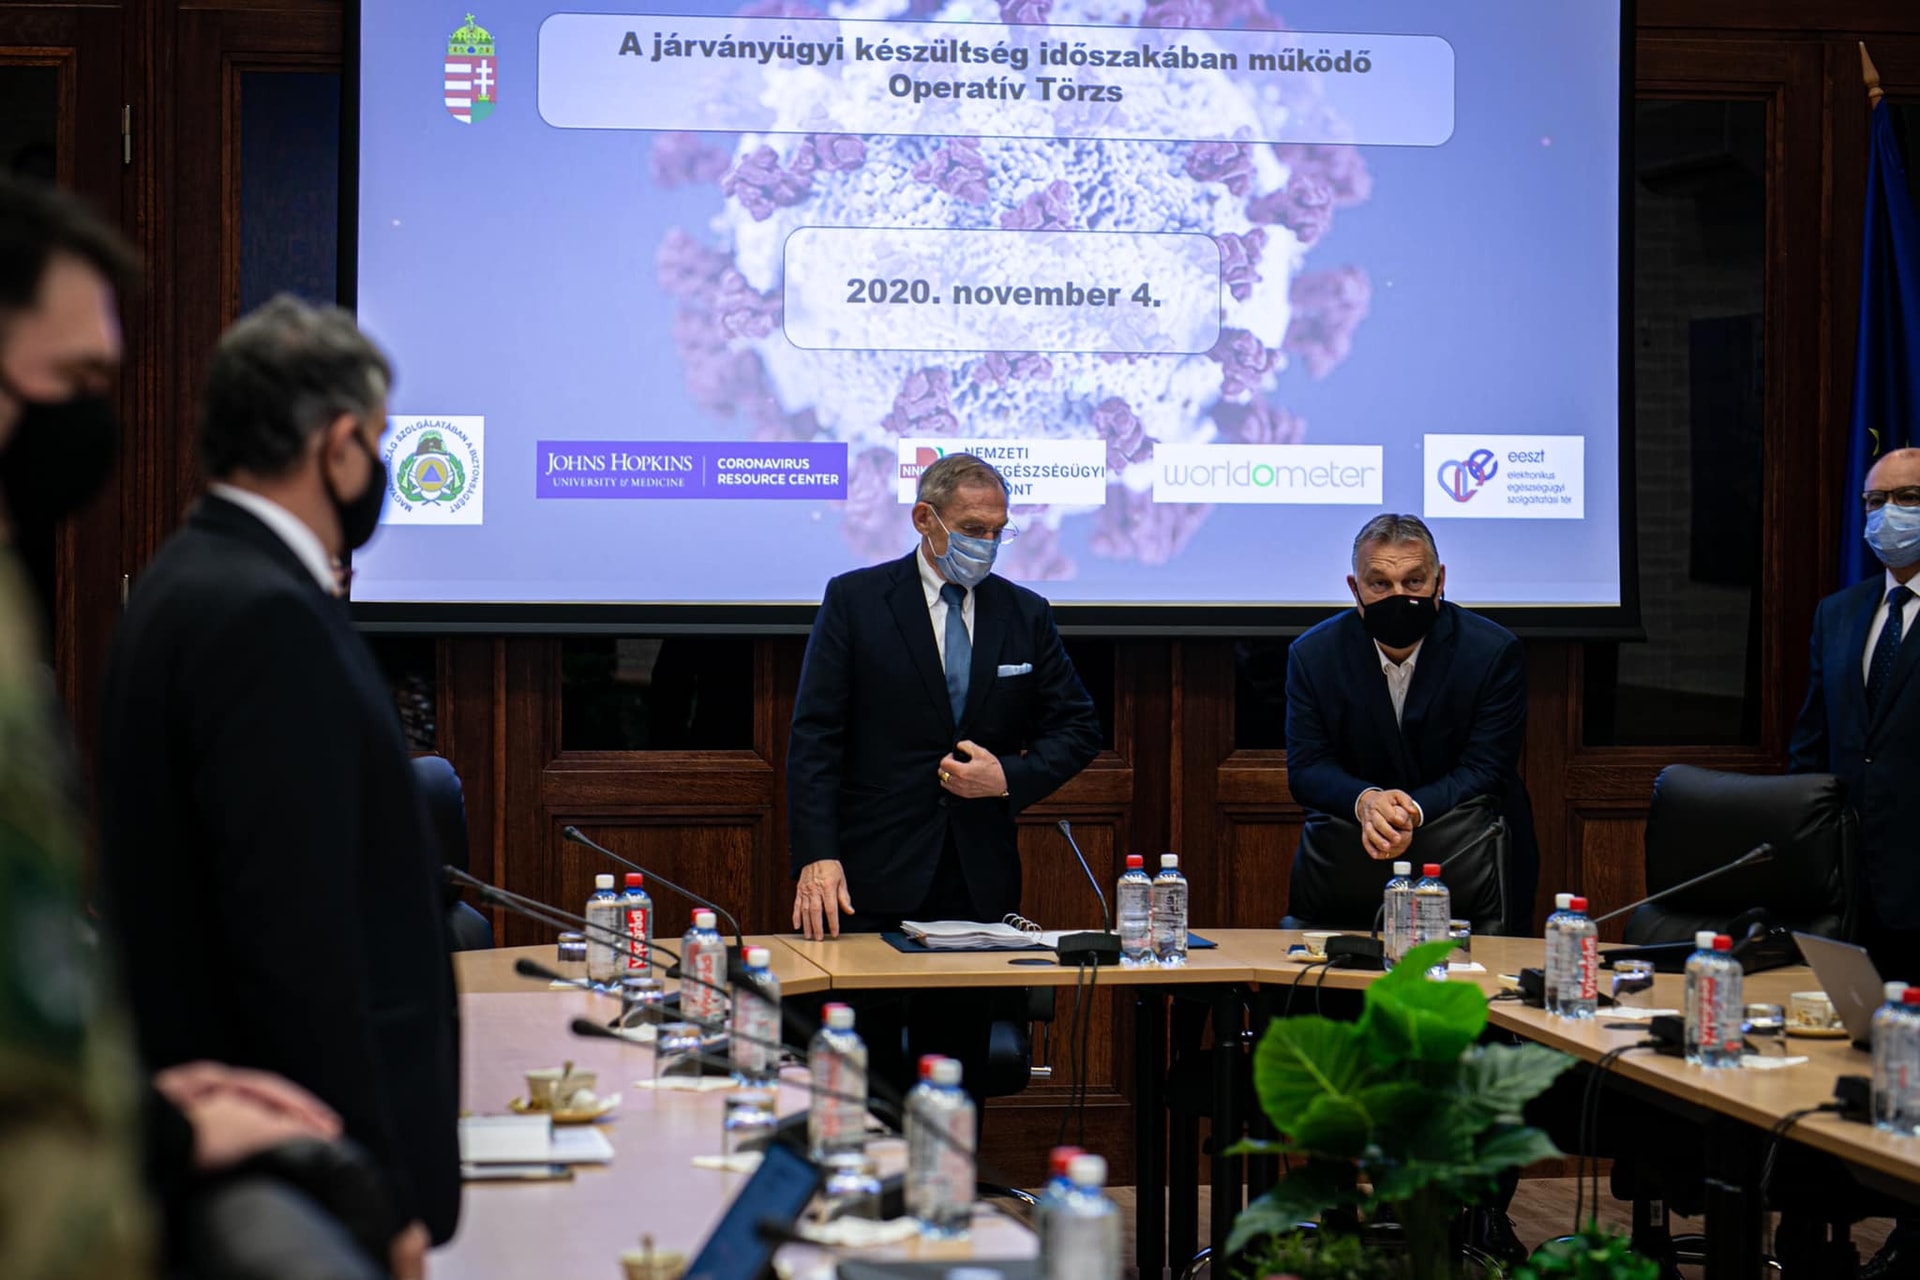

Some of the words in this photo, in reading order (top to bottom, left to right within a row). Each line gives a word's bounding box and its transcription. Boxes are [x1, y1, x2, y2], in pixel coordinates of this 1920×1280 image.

[618, 31, 643, 57] A
[650, 33, 844, 66] járványügyi
[855, 37, 1028, 69] készültség
[1039, 41, 1238, 71] időszakában
[1248, 47, 1372, 74] működő
[888, 73, 1026, 103] Operatív
[1036, 77, 1123, 103] Törzs
[846, 278, 941, 304] 2020.
[952, 281, 1121, 307] november
[1130, 282, 1162, 307] 4.
[964, 446, 1030, 460] NEMZETI
[1508, 449, 1545, 463] eeszt
[545, 452, 606, 475] JOHNS
[611, 452, 693, 472] HOPKINS
[717, 457, 810, 470] CORONAVIRUS
[995, 463, 1105, 479] EGÉSZSÉGÜGYI
[717, 473, 786, 486] RESOURCE
[789, 473, 839, 486] CENTER
[1163, 460, 1376, 488] worldometer
[1507, 471, 1556, 480] elektronikus
[553, 477, 617, 488] UNIVERSITY
[631, 477, 685, 488] MEDICINE
[628, 910, 647, 969] Vsegrádi
